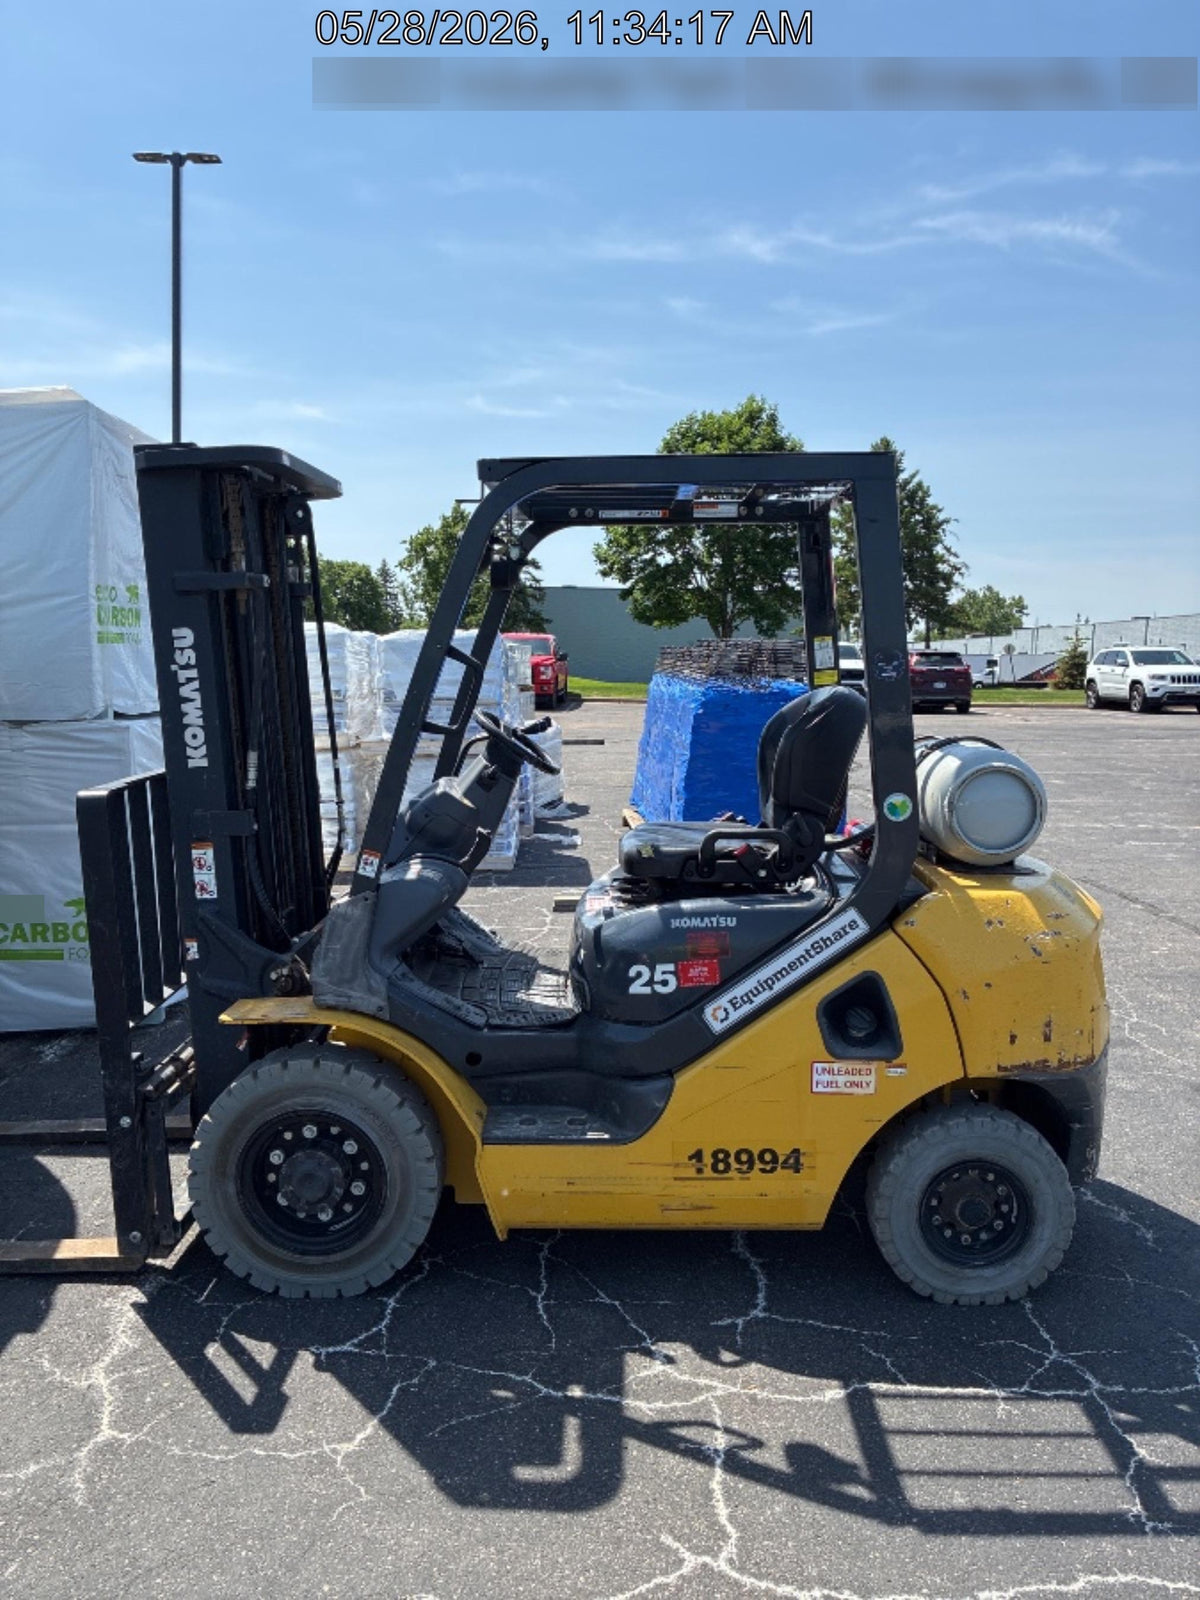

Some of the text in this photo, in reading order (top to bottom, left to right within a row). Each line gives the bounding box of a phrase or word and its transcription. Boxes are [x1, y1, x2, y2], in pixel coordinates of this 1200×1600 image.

[170, 626, 209, 769] KOMATSU
[0, 921, 89, 944] CARBO
[671, 914, 737, 929] KOMATSU
[727, 918, 860, 1012] EquipmentShare
[628, 963, 678, 994] 25
[815, 1066, 873, 1077] UNLEADED
[815, 1080, 873, 1089] FUEL ONLY
[687, 1148, 804, 1175] 18994
